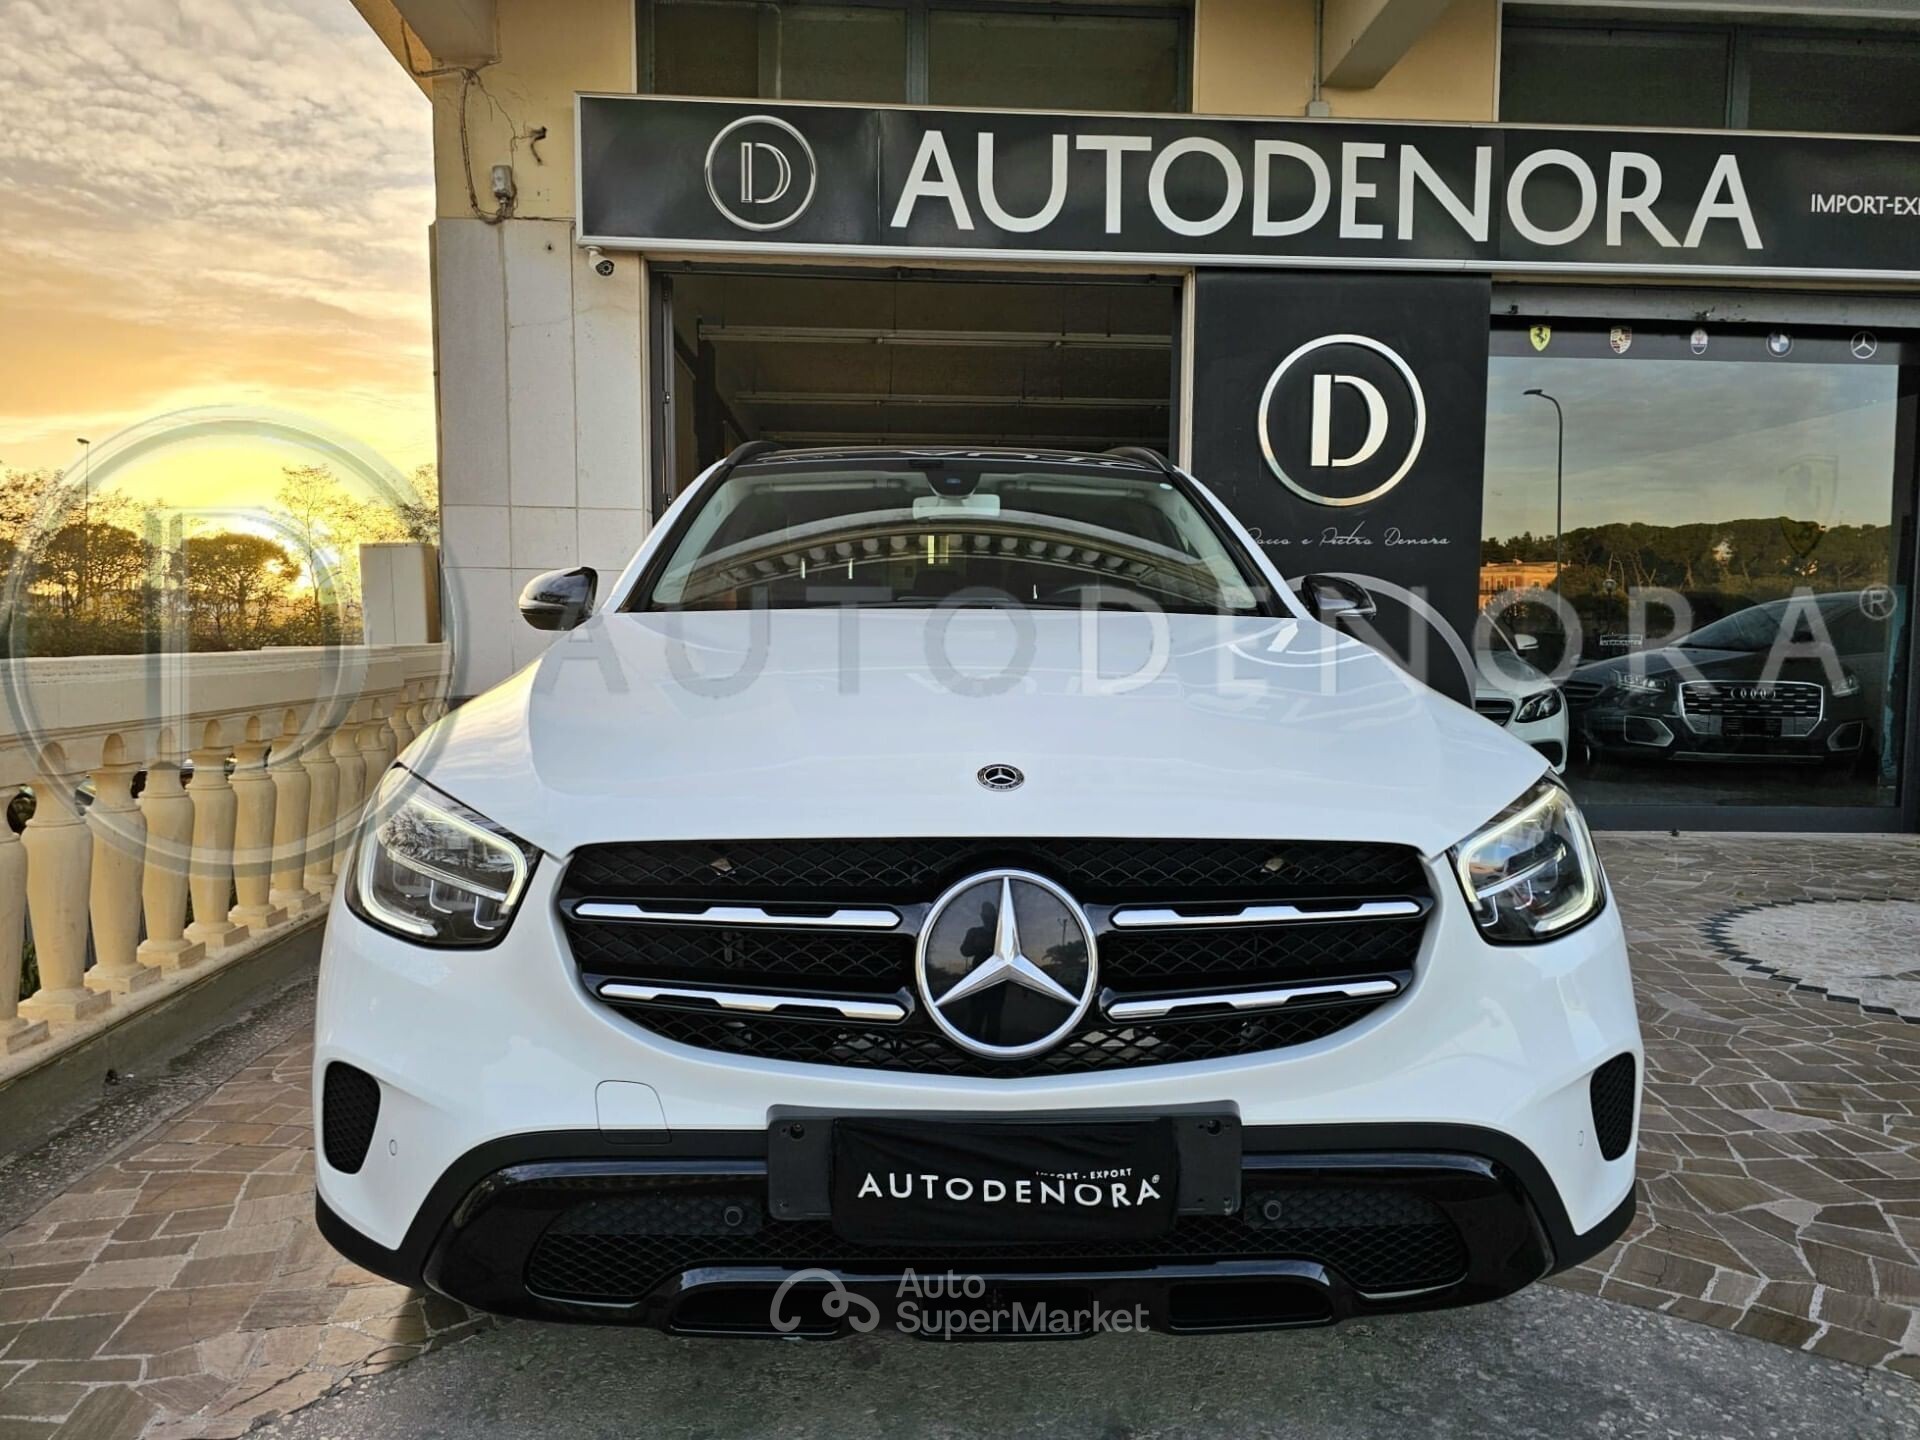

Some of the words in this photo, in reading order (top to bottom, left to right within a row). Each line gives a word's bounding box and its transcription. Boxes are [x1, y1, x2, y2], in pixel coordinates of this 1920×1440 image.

[890, 129, 1764, 250] AUTODENORA
[1311, 373, 1389, 467] D
[1090, 1168, 1132, 1180] EXPORT
